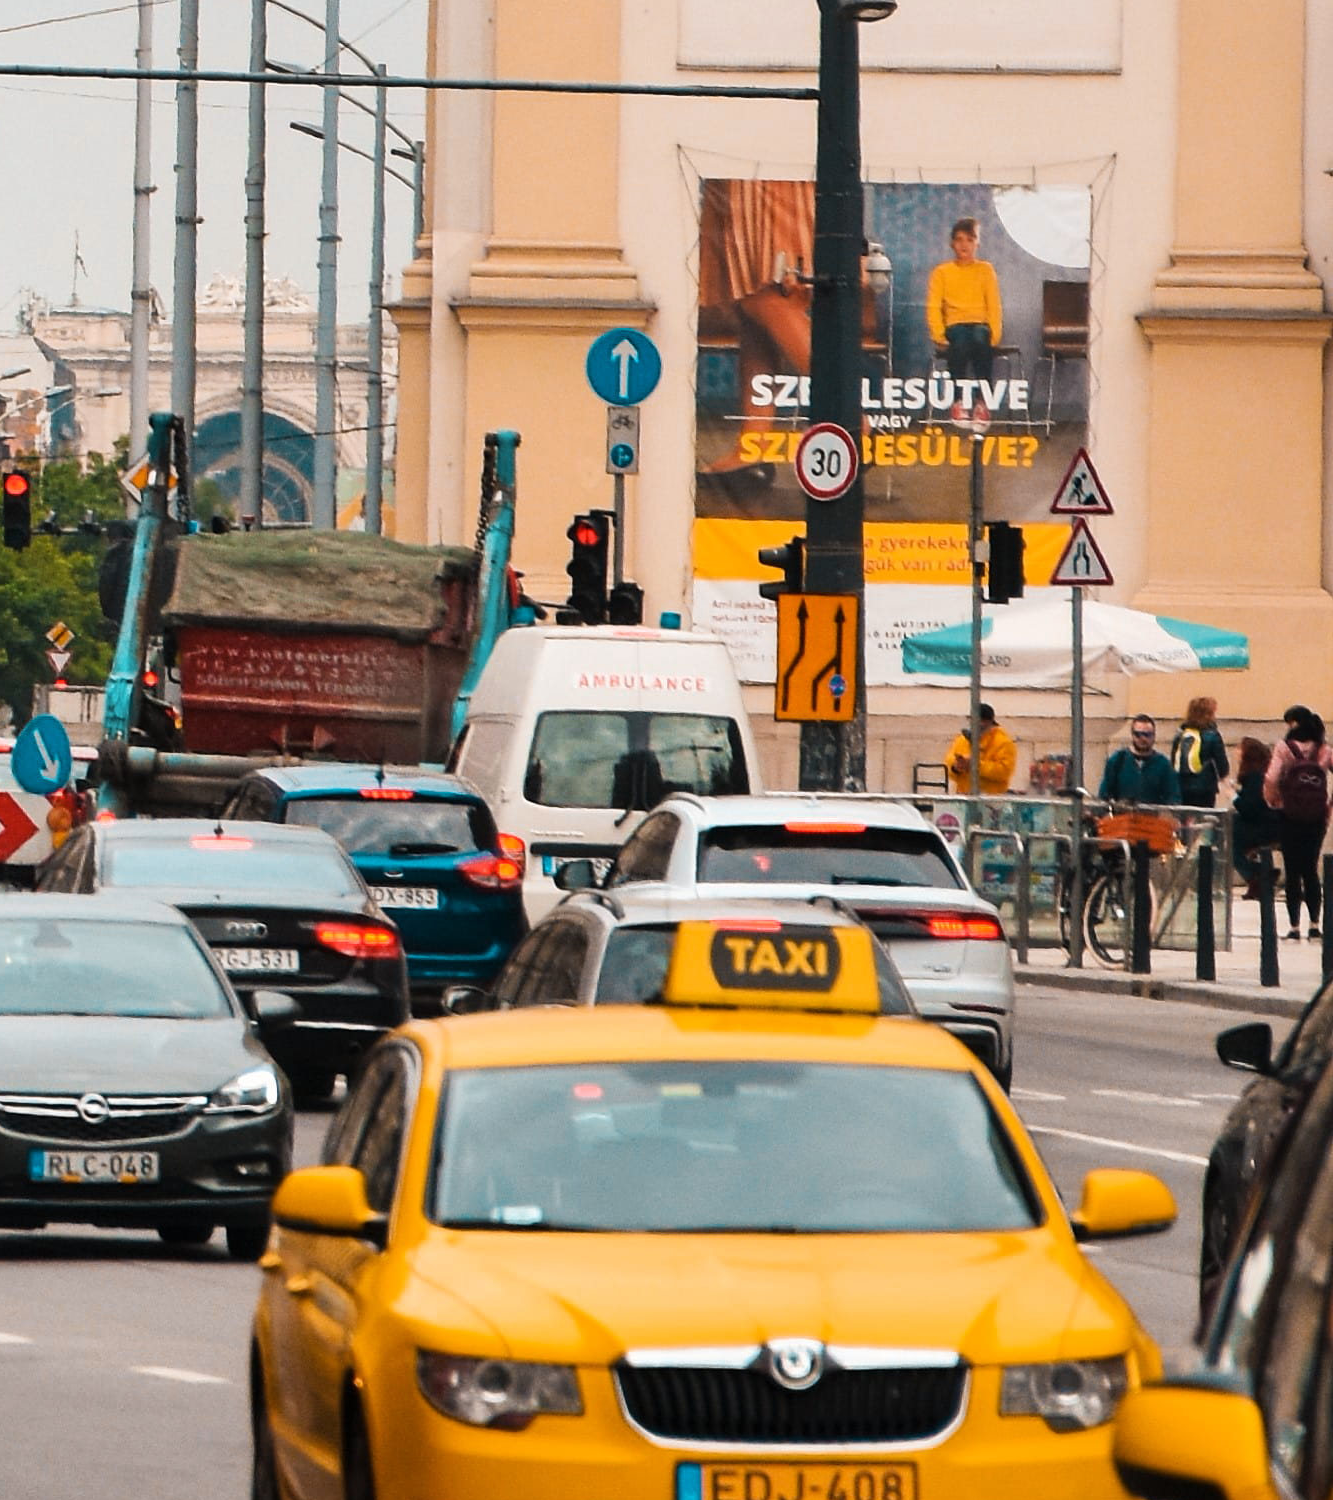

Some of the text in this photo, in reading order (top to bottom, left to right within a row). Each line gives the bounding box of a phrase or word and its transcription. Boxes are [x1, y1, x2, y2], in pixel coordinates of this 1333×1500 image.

[866, 414, 912, 429] VAGY
[811, 447, 842, 479] 30
[579, 674, 706, 692] AMBULANCE
[371, 888, 435, 906] DX-853
[724, 936, 829, 977] TAXI
[48, 1154, 153, 1177] RLC-048
